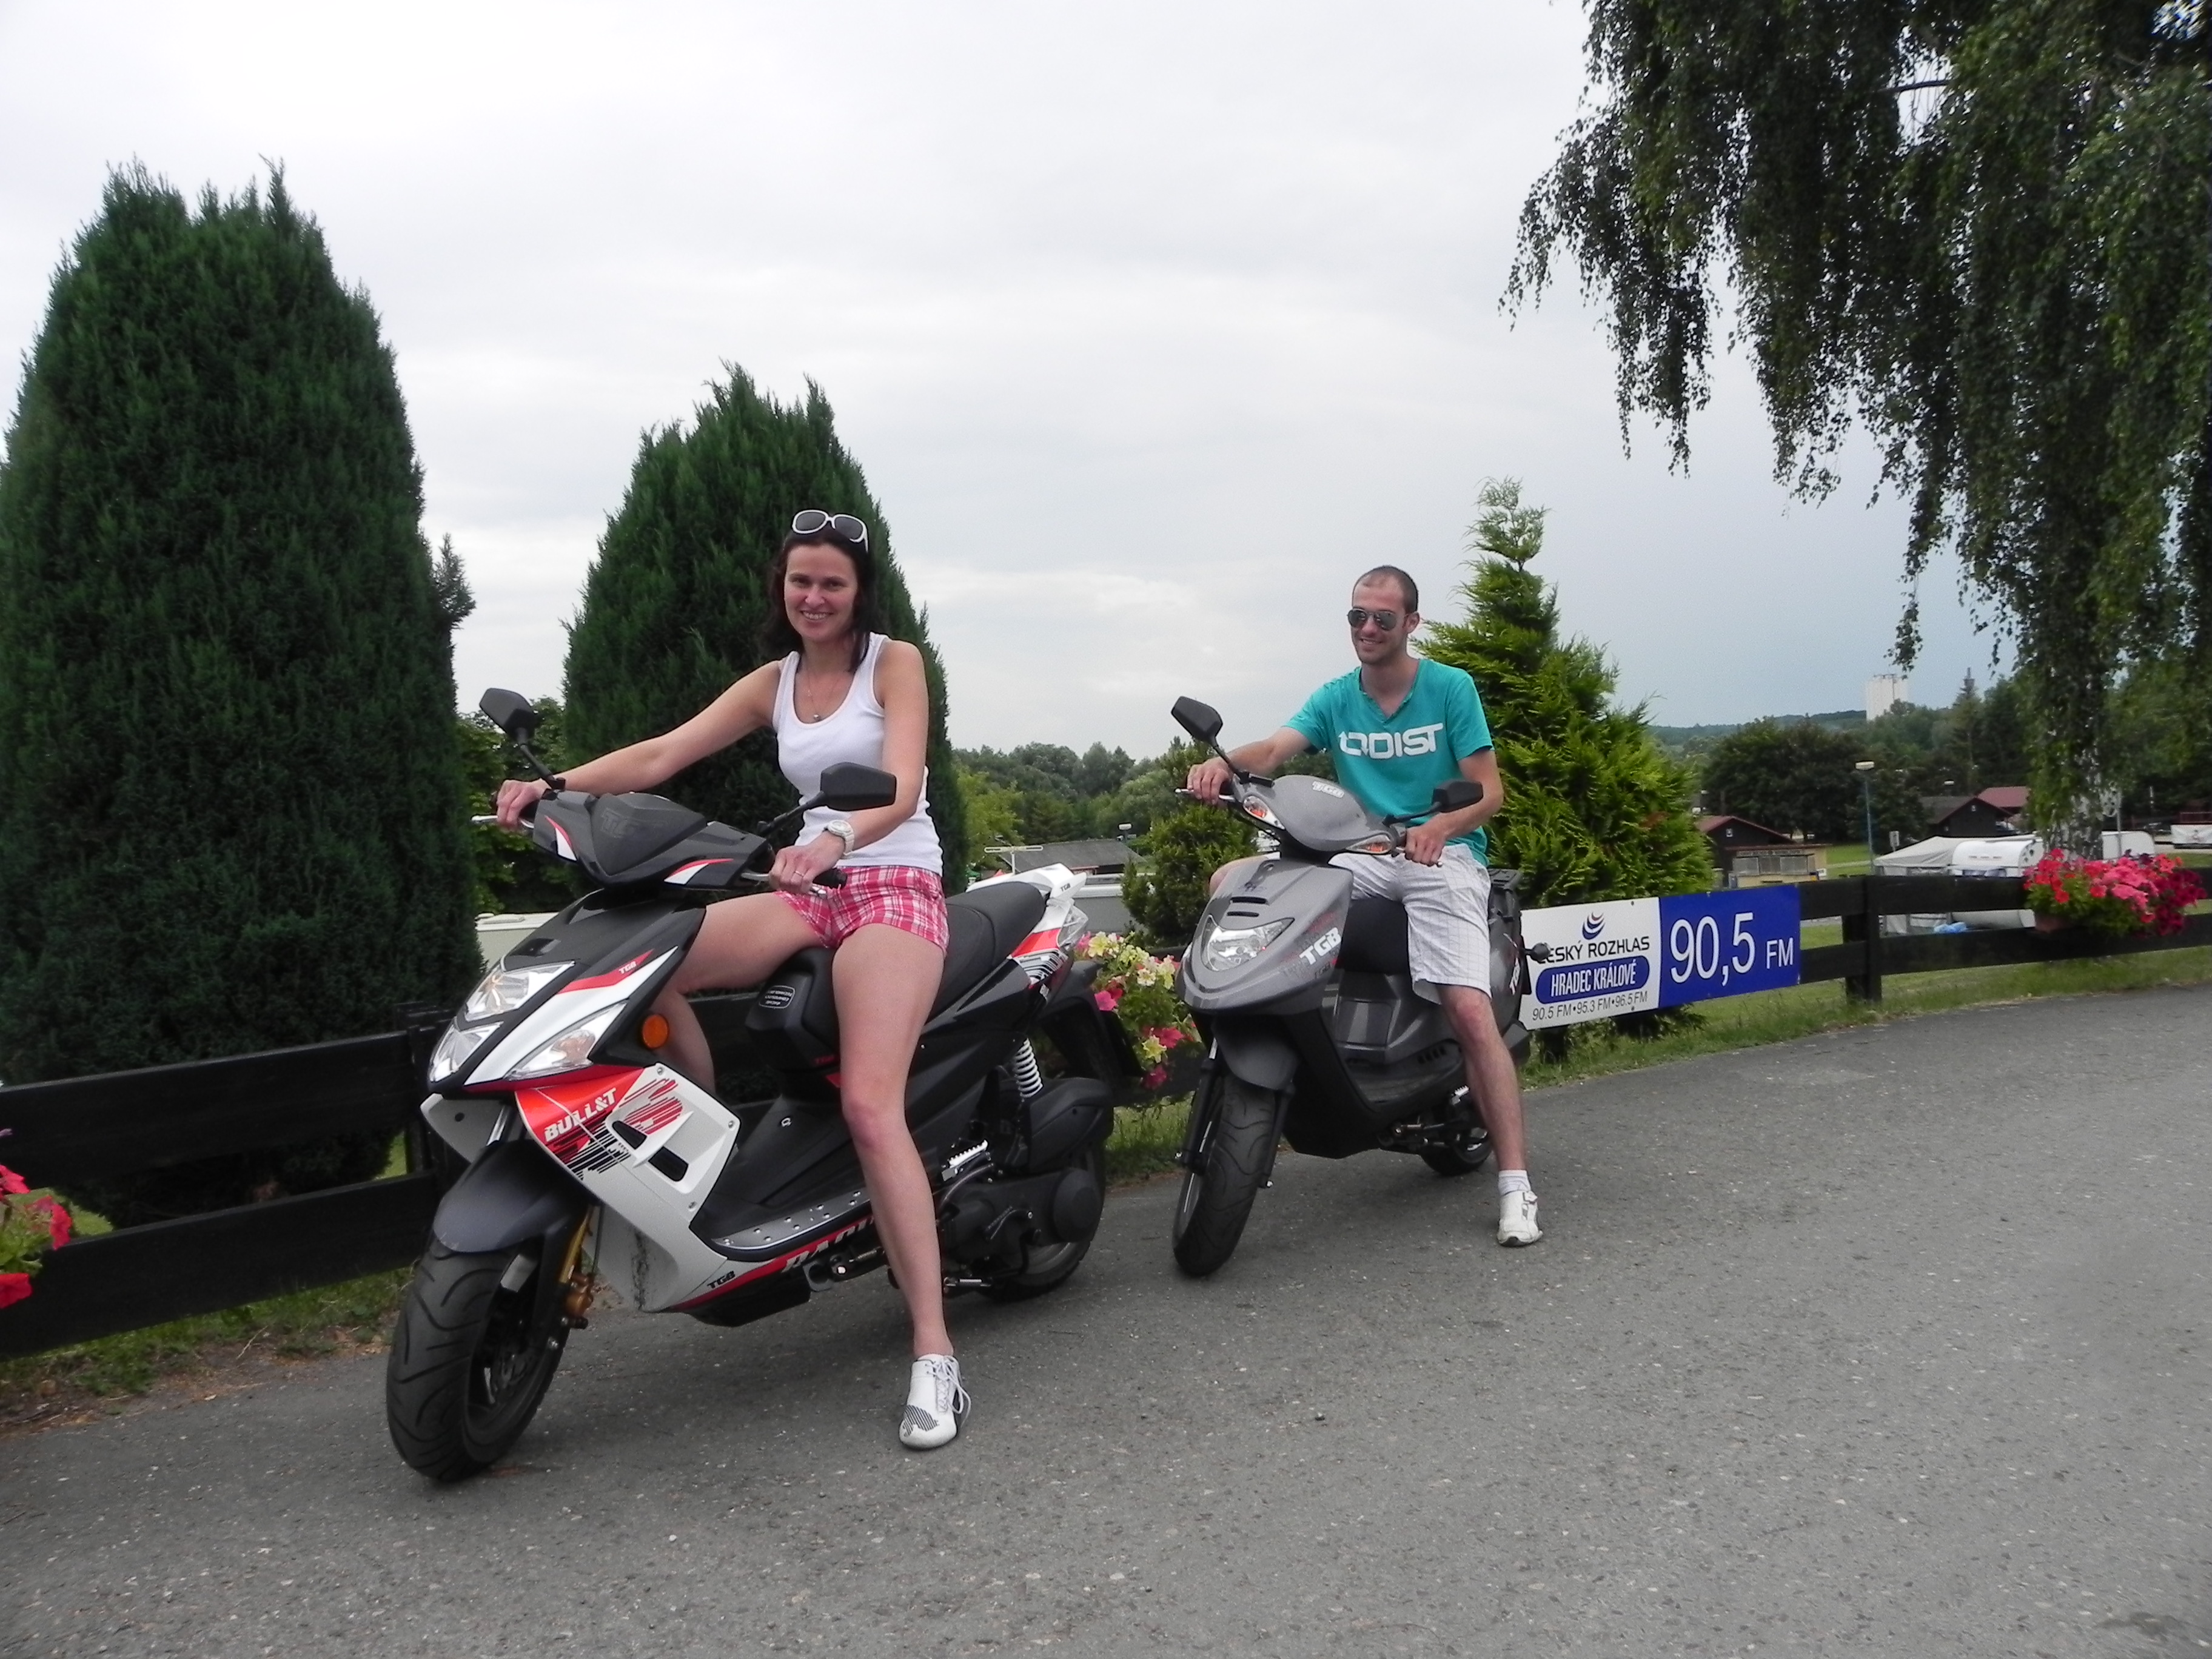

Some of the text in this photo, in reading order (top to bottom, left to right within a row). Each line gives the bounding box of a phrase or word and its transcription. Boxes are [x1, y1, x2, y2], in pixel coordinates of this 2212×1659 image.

[1061, 883, 1071, 891] TGB
[1299, 927, 1341, 965] TGB
[1539, 936, 1651, 964] ESKÝ ROZHLAS
[1670, 912, 1794, 987] 90,5 FM
[618, 960, 637, 974] TGB
[1550, 959, 1637, 997] HRADEC KRÁLOVÉ
[1532, 1006, 1554, 1021] 90.5
[1634, 991, 1647, 1004] FM
[707, 1270, 736, 1289] TGB
